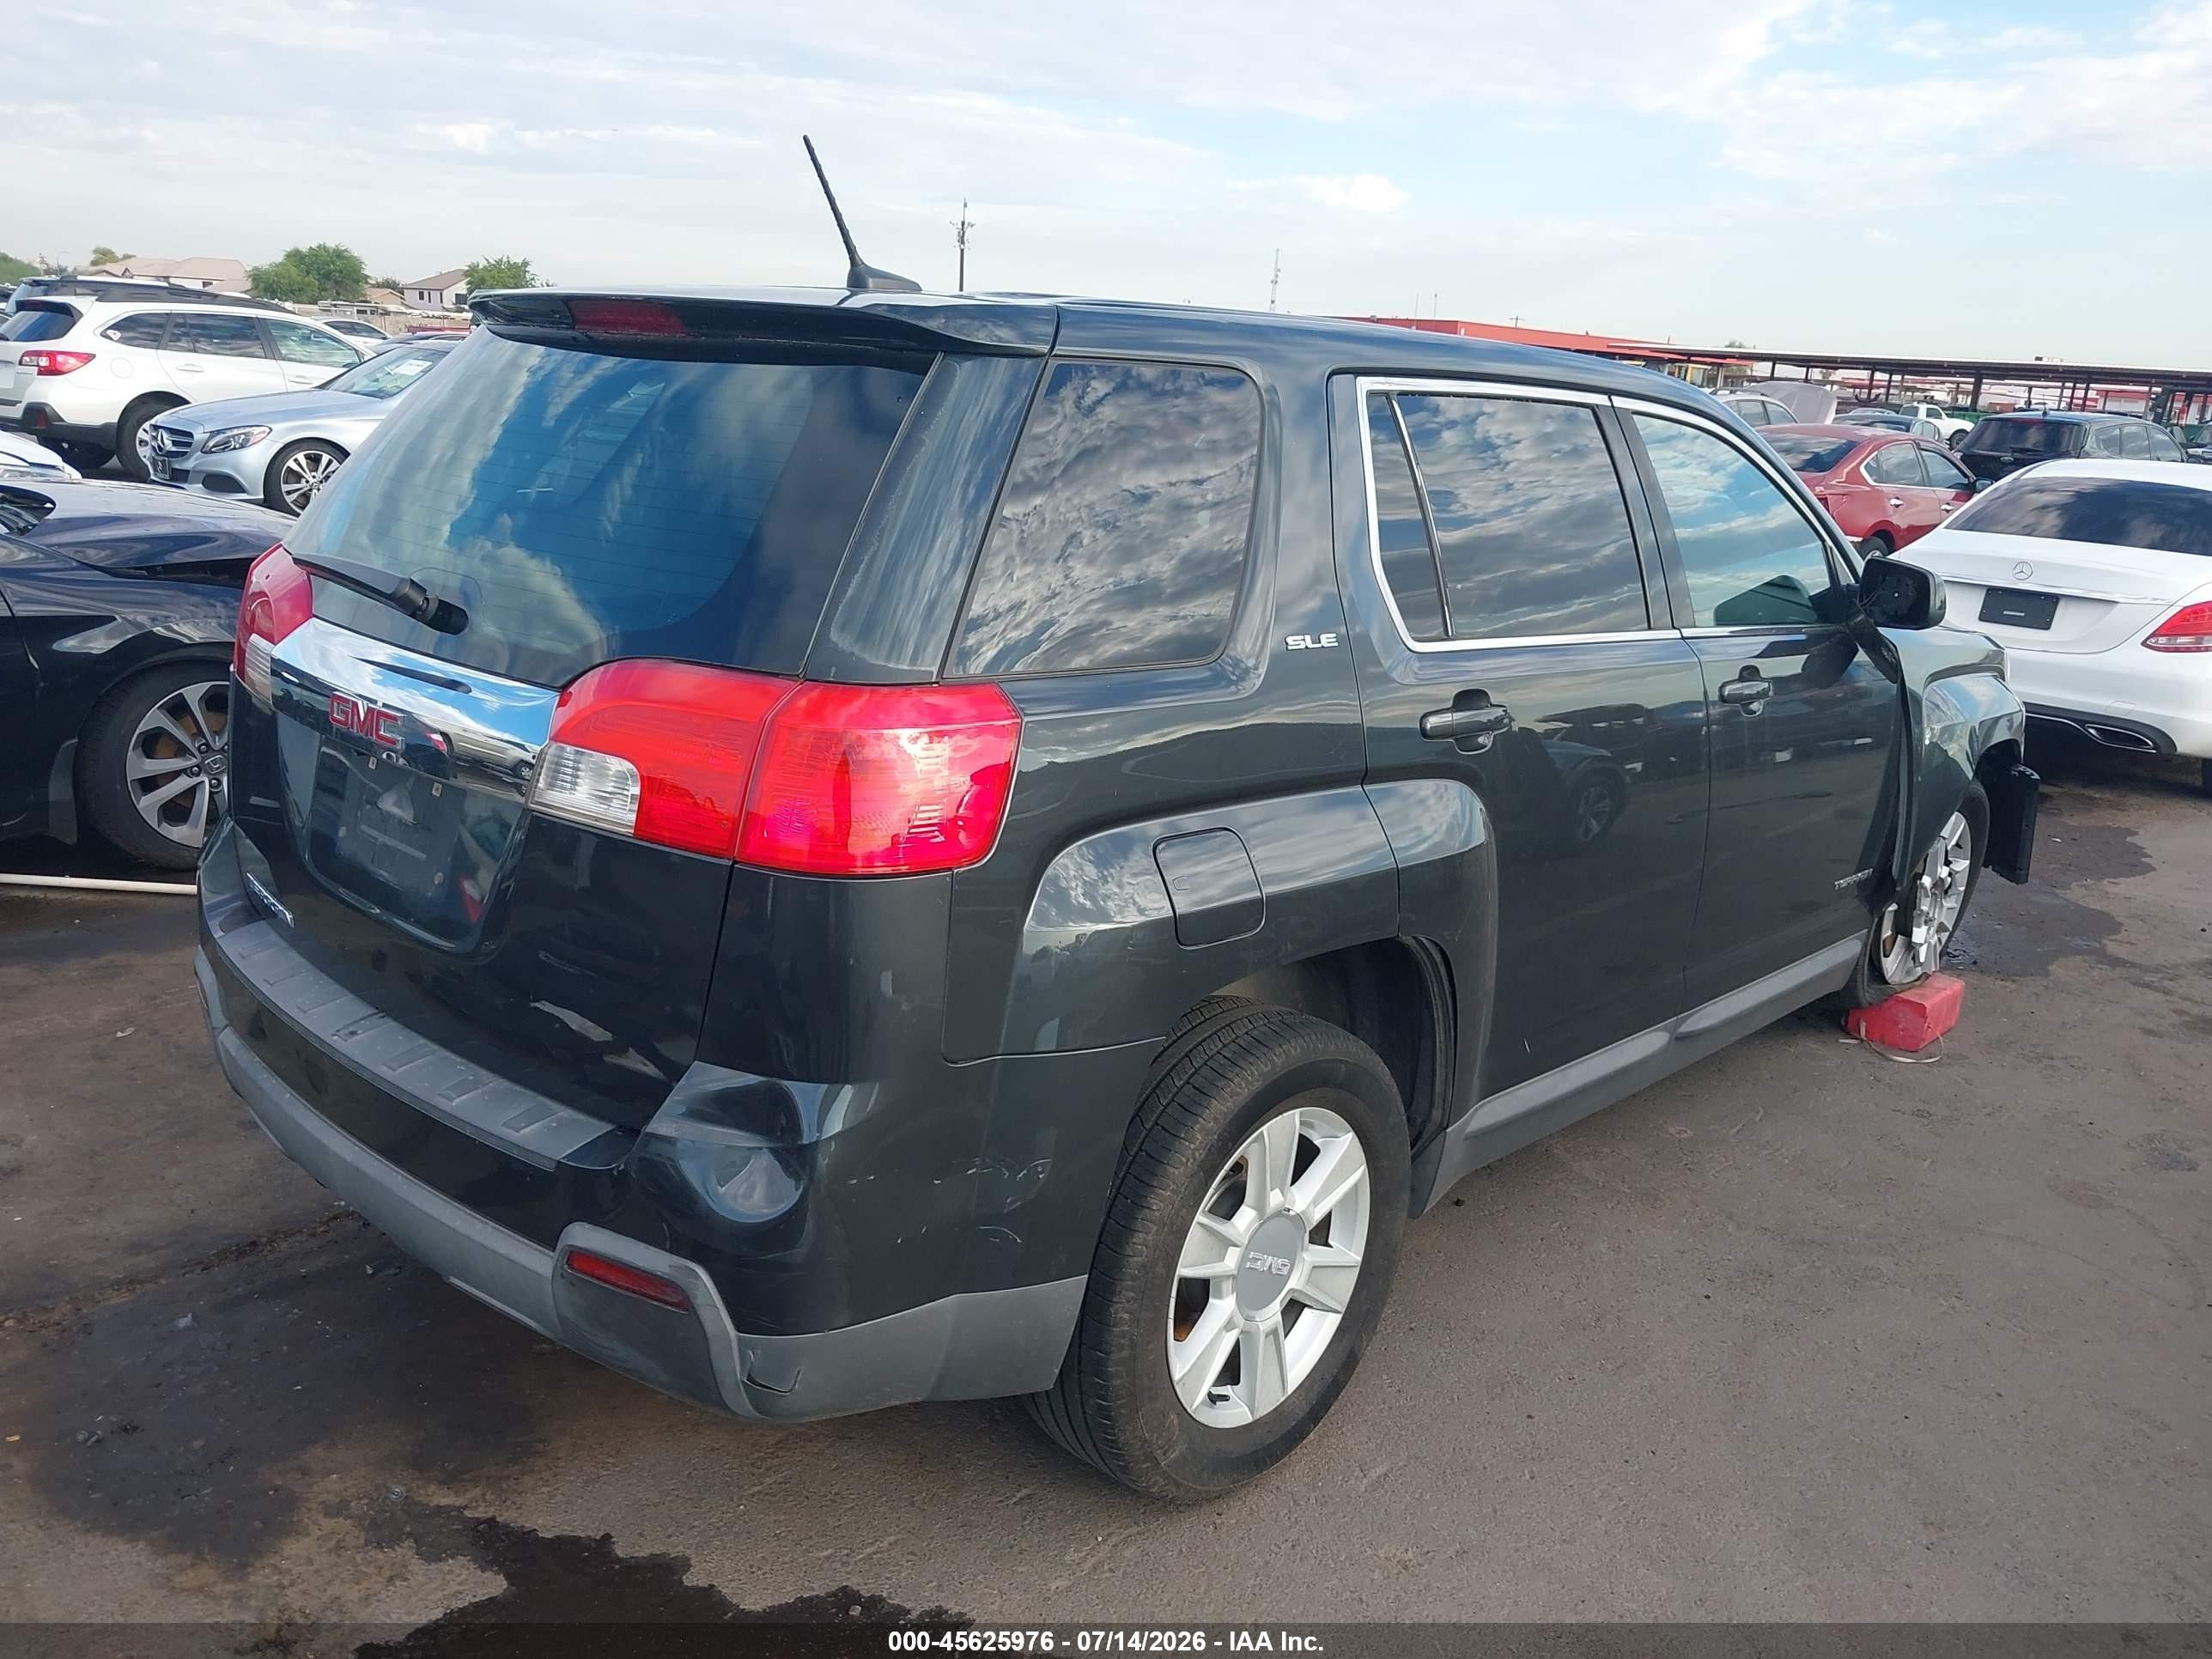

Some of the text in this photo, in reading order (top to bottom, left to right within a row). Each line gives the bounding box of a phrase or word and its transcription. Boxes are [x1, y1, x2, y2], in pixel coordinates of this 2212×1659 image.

[1285, 632, 1339, 650] SLE
[330, 691, 405, 749] GMC
[1245, 1251, 1291, 1275] GMC
